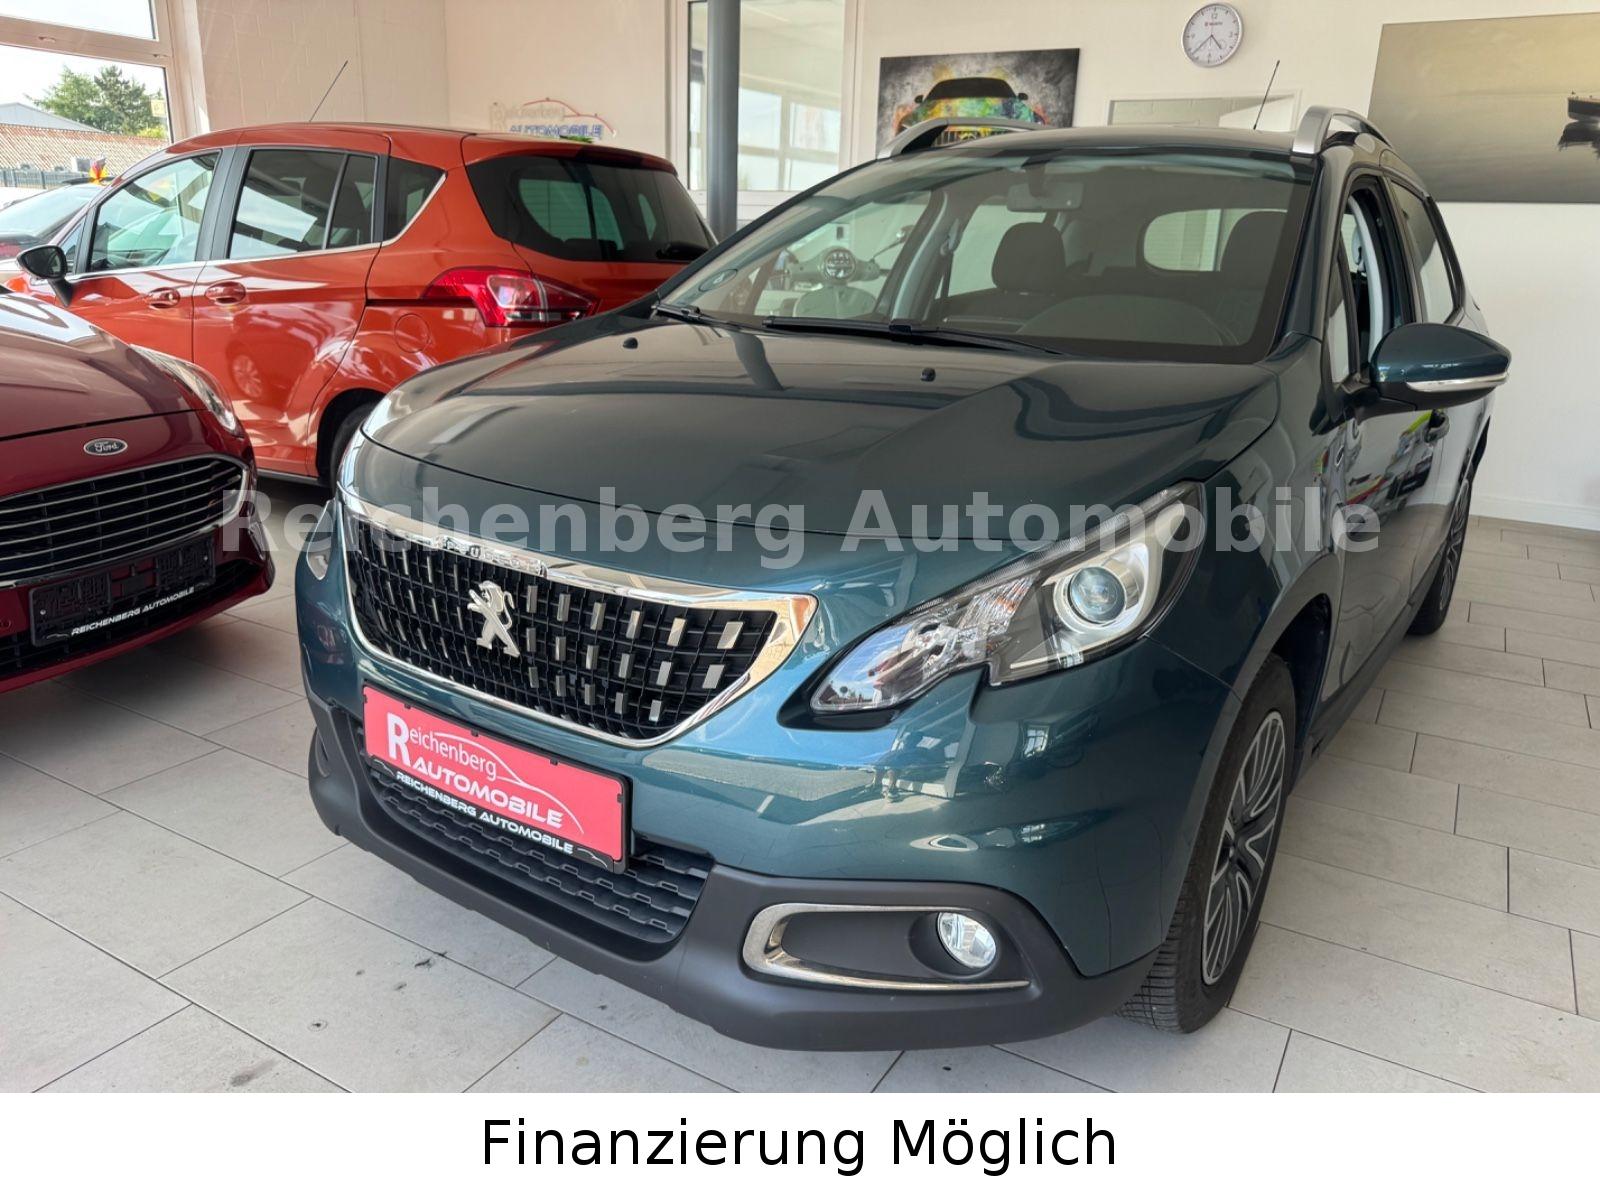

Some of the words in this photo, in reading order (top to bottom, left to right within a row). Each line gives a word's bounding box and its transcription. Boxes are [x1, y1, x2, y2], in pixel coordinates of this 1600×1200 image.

[94, 441, 120, 453] Ford
[71, 608, 141, 636] REICHENBERG
[142, 586, 195, 613] AUTOMOBILE
[387, 712, 497, 782] Reichenberg
[396, 771, 477, 818] REICHENBERG
[479, 811, 574, 855] AUTOMOBILE
[413, 757, 563, 829] AUTOMOBILE
